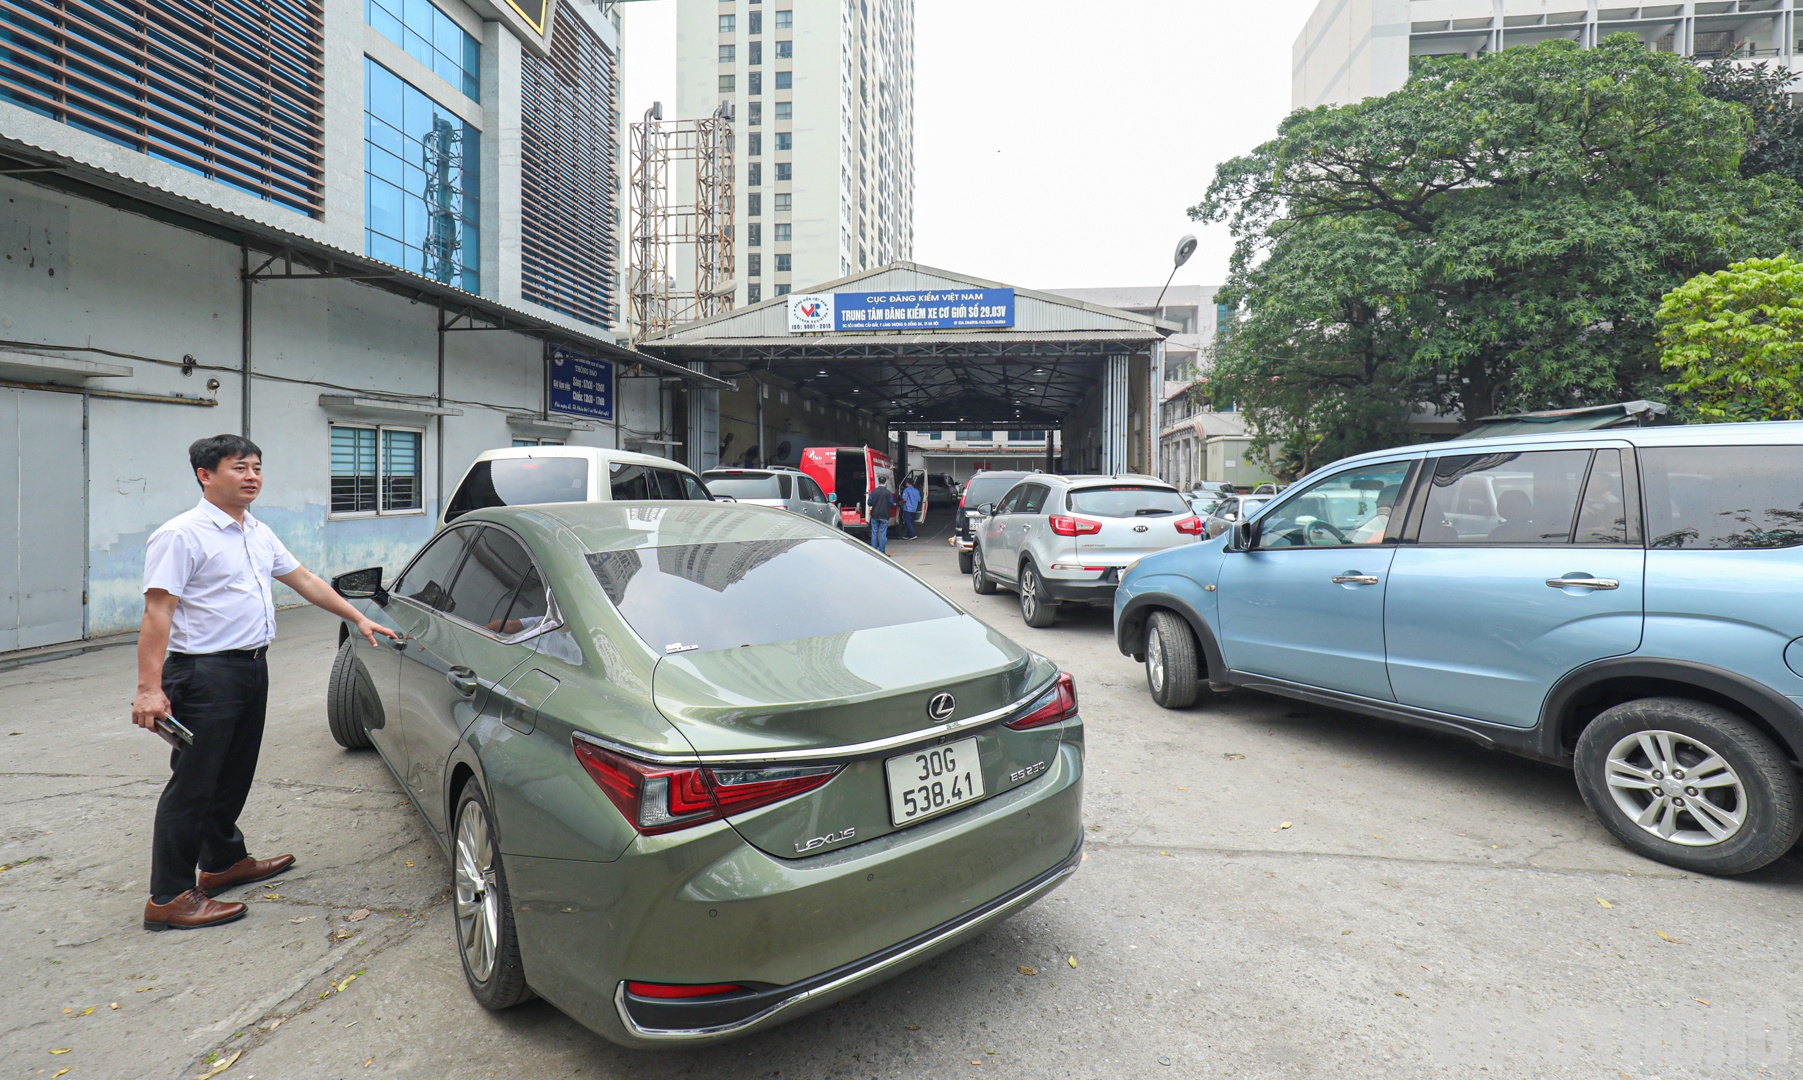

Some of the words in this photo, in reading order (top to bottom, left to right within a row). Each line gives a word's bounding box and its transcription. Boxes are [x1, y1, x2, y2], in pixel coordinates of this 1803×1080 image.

[866, 296, 886, 304] CỤC
[890, 294, 916, 303] ĐĂNG
[918, 292, 939, 302] KIỂM
[942, 292, 959, 302] VIỆT
[842, 310, 865, 321] TRUNG
[867, 306, 884, 320] TÂM
[885, 306, 905, 320] ĐĂNG
[907, 303, 926, 319] KIỂM
[928, 308, 937, 319] XE
[939, 306, 950, 319] CƠ
[952, 304, 967, 318] GIỚI
[968, 303, 979, 318] SỐ
[980, 306, 1006, 318] 29.03V
[915, 748, 956, 781] 30G
[1010, 770, 1025, 782] ES
[902, 772, 975, 817] 538.41
[794, 828, 856, 853] LEXUS
